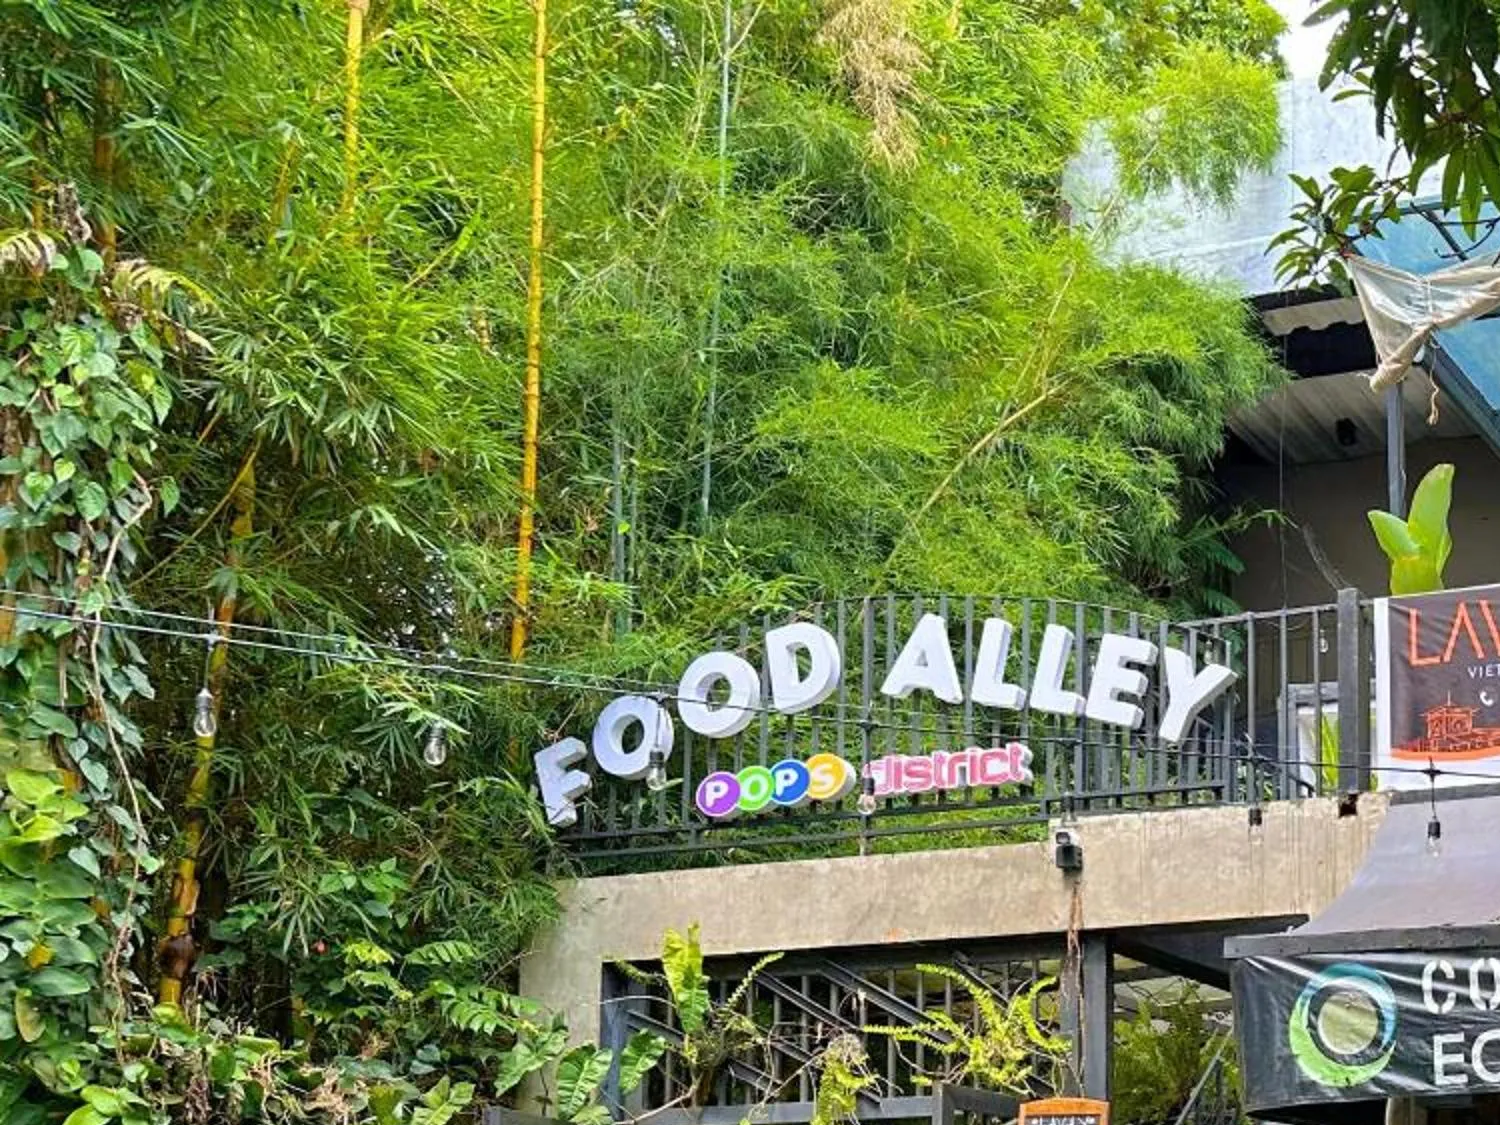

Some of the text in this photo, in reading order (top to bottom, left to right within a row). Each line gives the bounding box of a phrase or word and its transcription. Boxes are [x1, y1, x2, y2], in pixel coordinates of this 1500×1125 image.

[535, 613, 1238, 827] FOOD ALLEY
[700, 742, 1029, 812] POPS district
